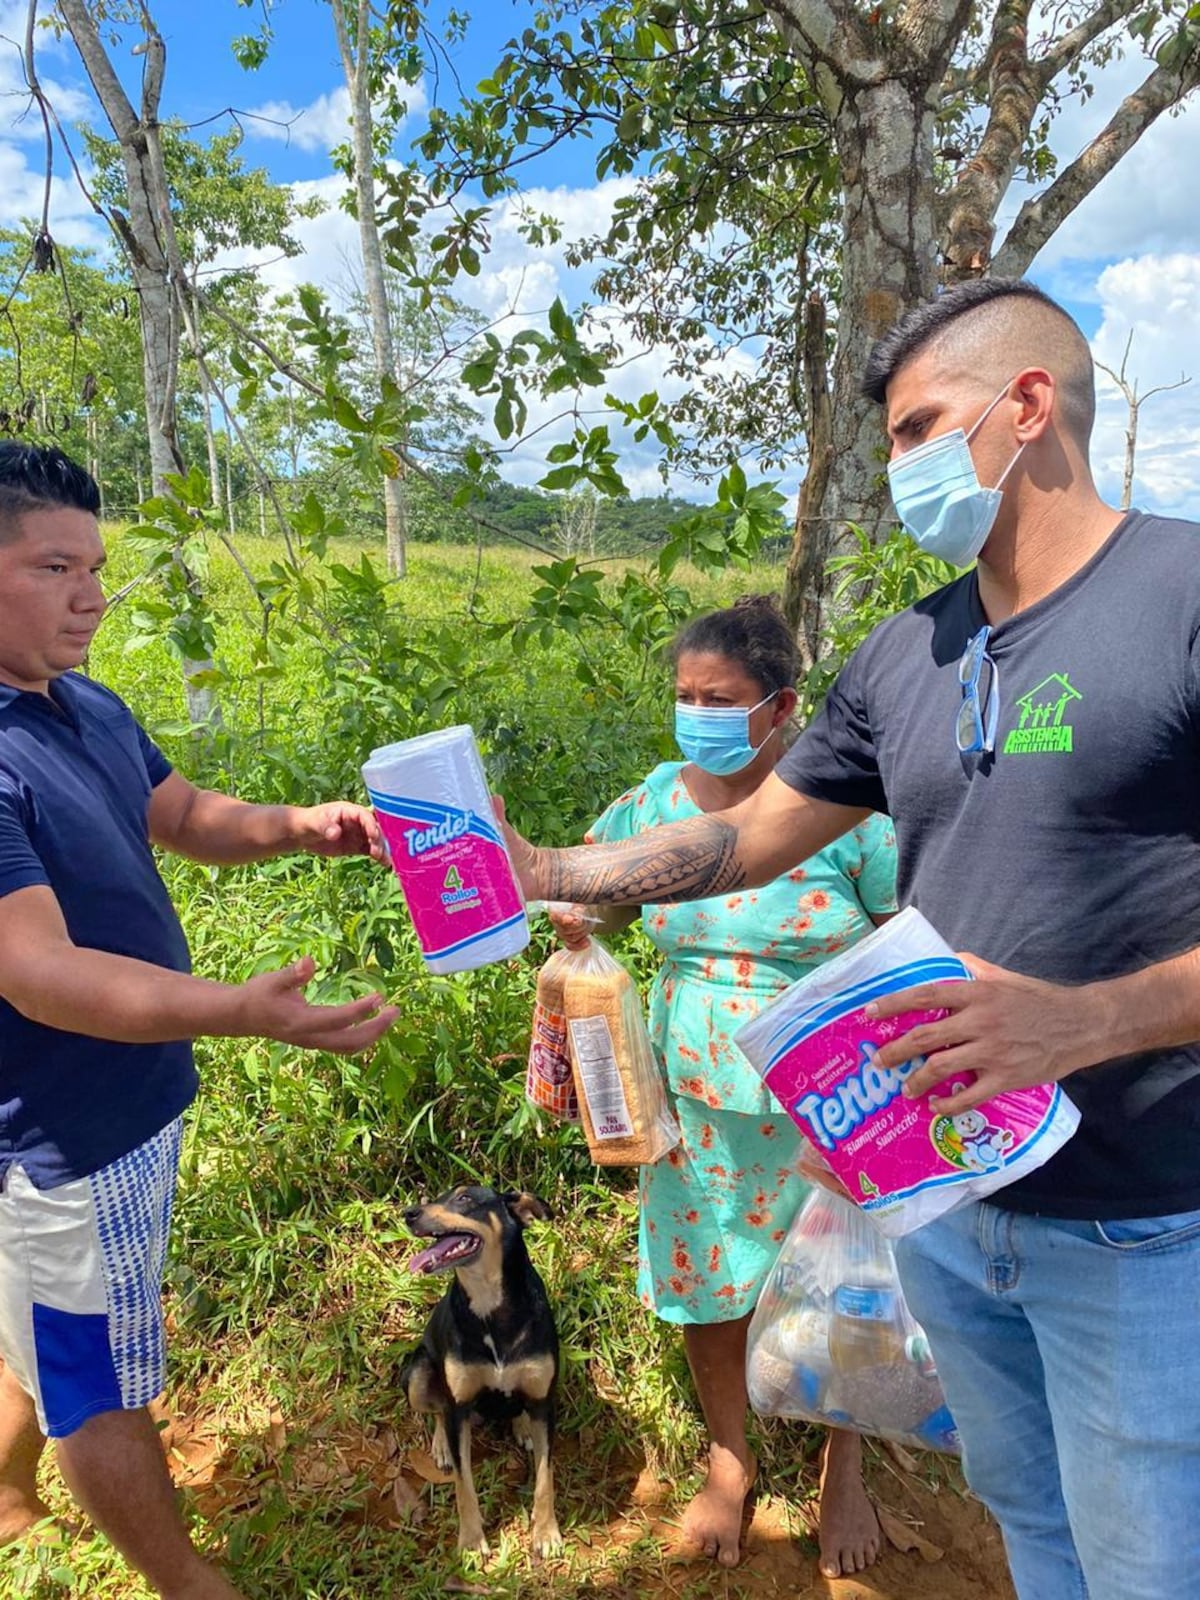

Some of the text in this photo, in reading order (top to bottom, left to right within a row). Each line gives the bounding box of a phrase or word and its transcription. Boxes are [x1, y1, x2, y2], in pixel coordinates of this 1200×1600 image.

[402, 809, 475, 858] Tender
[444, 864, 464, 890] 4
[441, 887, 478, 904] Rollos
[795, 1040, 928, 1152] Tend
[858, 1170, 879, 1198] 4
